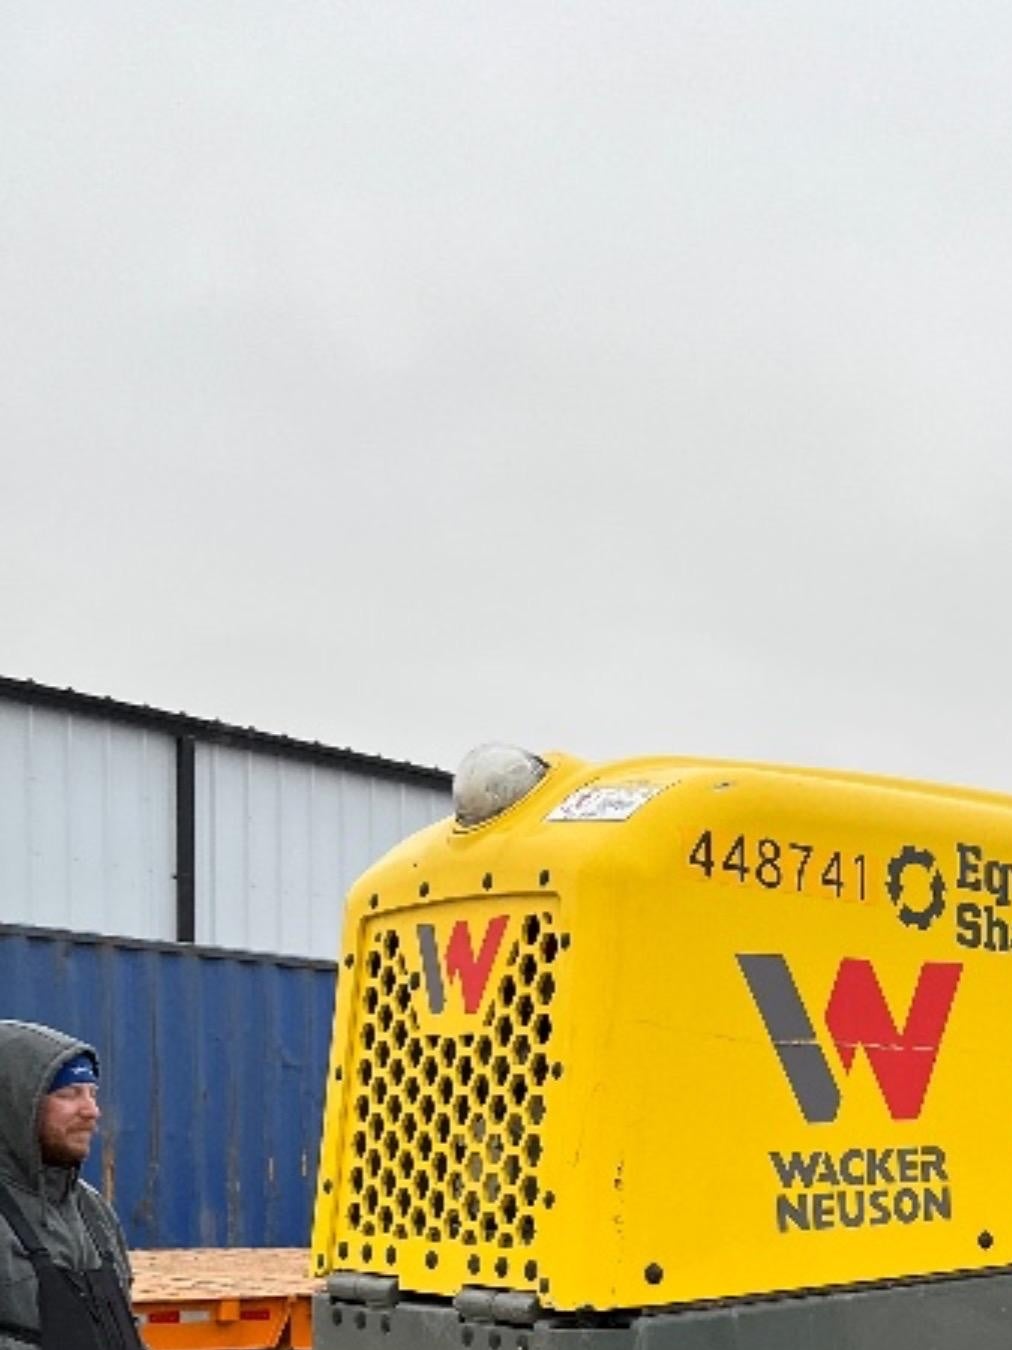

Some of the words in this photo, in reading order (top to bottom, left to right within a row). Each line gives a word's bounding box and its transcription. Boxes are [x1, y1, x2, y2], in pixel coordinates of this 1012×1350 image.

[689, 829, 865, 901] 448741
[768, 1145, 949, 1188] WACKER
[776, 1185, 952, 1233] NEUSON
